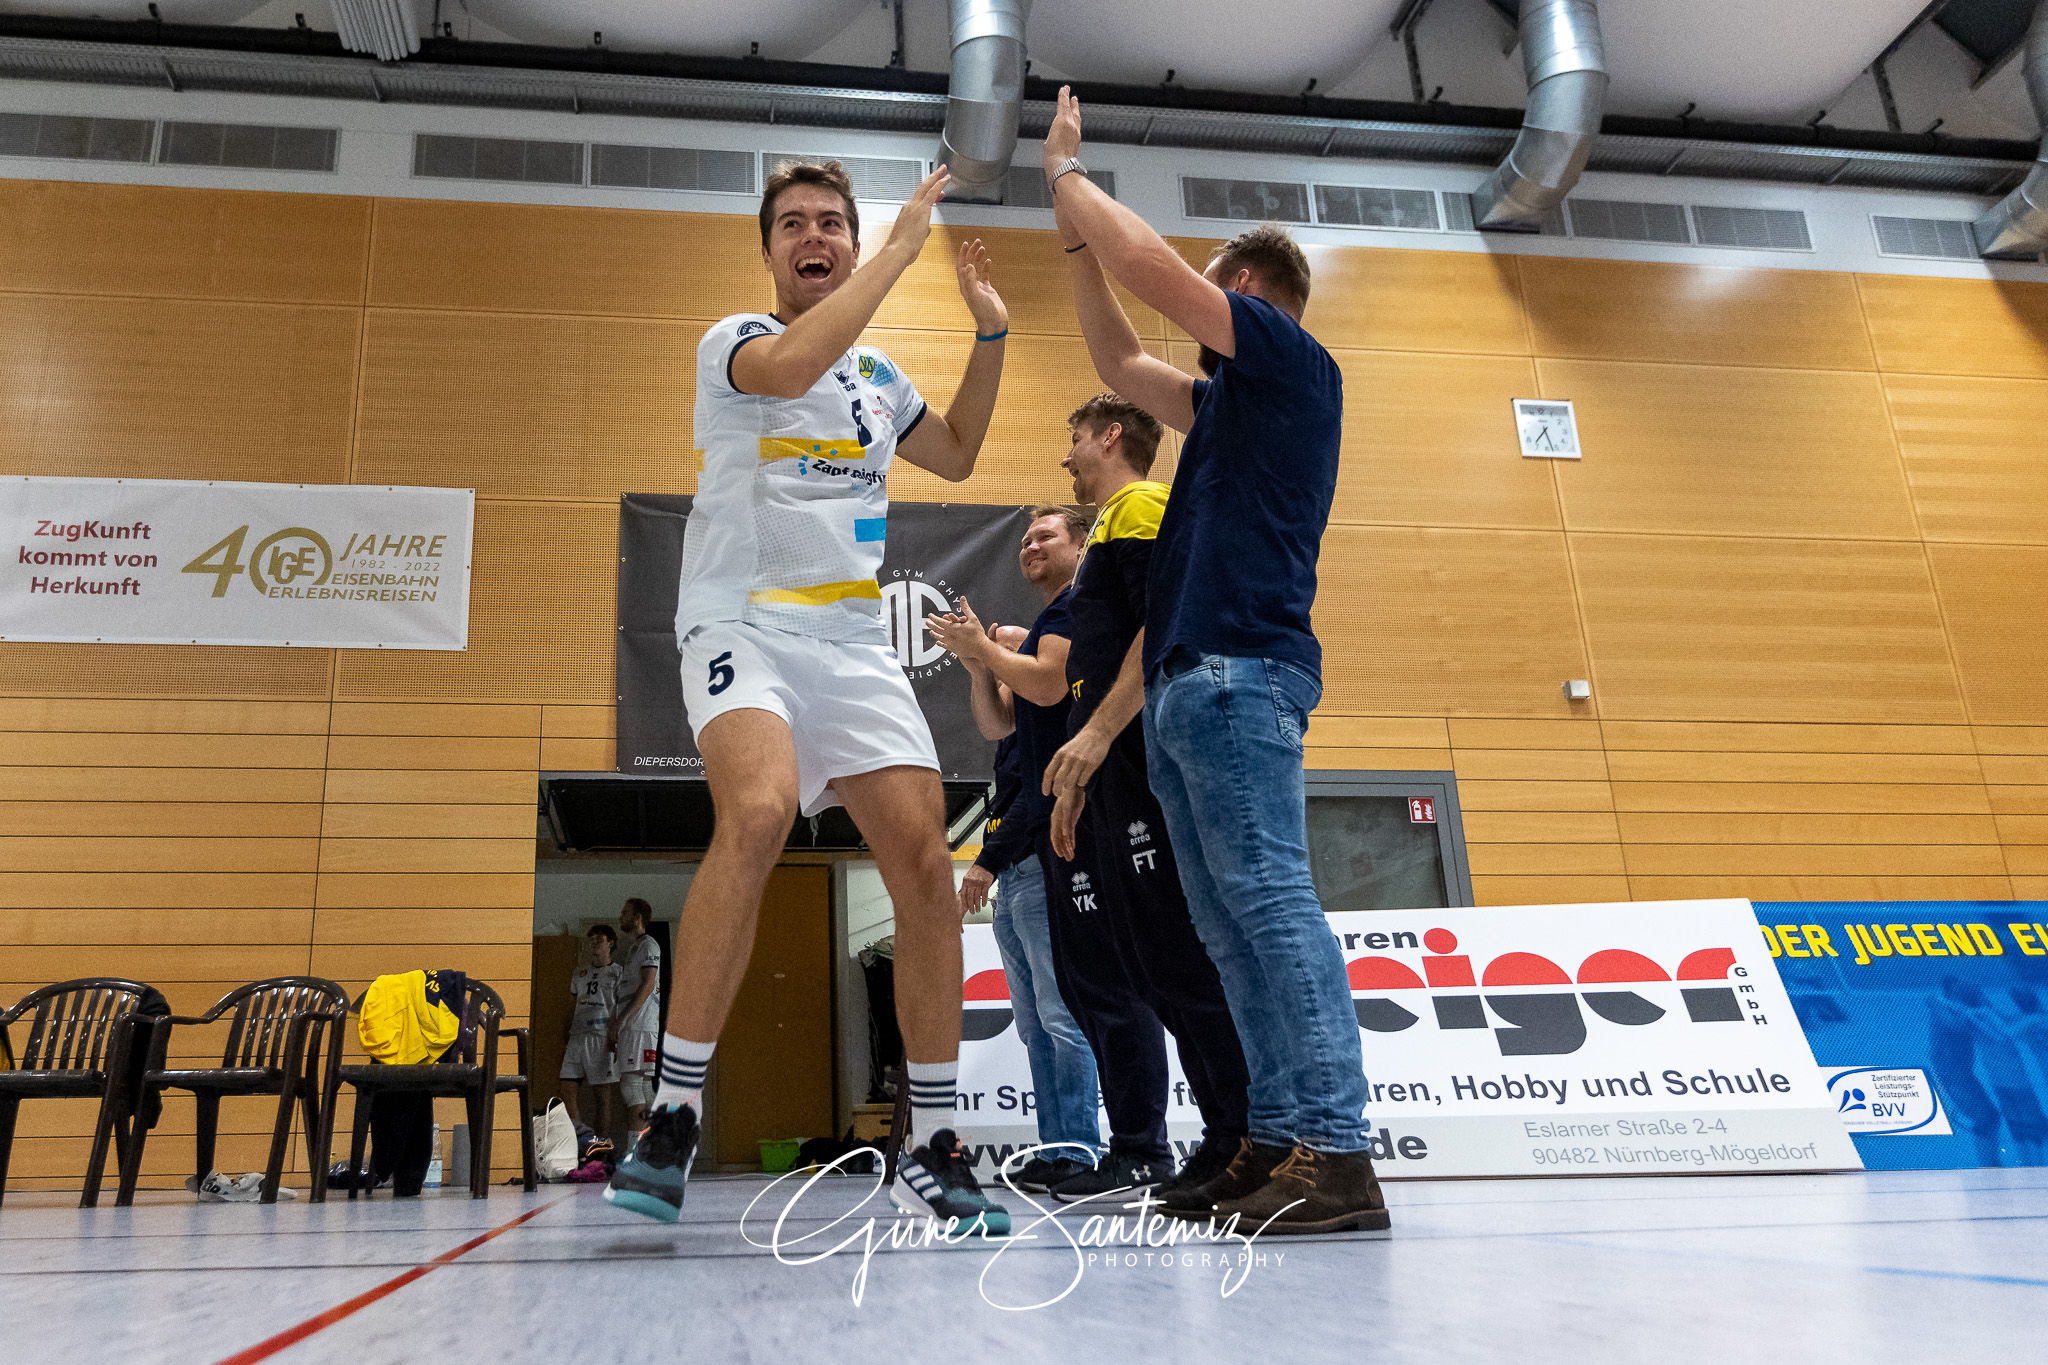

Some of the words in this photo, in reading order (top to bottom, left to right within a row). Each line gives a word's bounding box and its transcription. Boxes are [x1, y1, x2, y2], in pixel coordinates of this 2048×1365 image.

[34, 520, 151, 542] ZugKunft
[19, 545, 107, 566] kommt
[114, 554, 158, 567] von
[339, 533, 447, 561] JAHRE
[267, 546, 316, 584] IGE
[351, 559, 386, 569] 1982
[405, 561, 441, 572] 2022
[893, 569, 923, 579] GYM
[31, 576, 141, 595] Herkunft
[331, 573, 440, 587] EISENBAHN
[268, 586, 437, 602] ERLEBNISREISEN
[708, 651, 735, 696] 5
[634, 756, 704, 767] DIEPERSDOR
[1132, 849, 1157, 874] FT
[1072, 893, 1098, 913] YK
[1334, 931, 1419, 950] ren
[1844, 923, 2003, 965] JUGEND
[586, 981, 599, 995] 13
[1366, 1082, 1442, 1106] ren,
[1451, 1073, 1568, 1105] Hobby
[1582, 1070, 1653, 1098] und
[1662, 1067, 1791, 1096] Schule
[1871, 1074, 1916, 1082] Zertifizierter
[1874, 1082, 1915, 1091] Leistungs-
[1877, 1090, 1920, 1099] Stützpunkt
[1871, 1102, 1905, 1117] BVV
[1523, 1120, 1610, 1138] Eslarner
[1617, 1118, 1688, 1136] Straße
[1692, 1117, 1728, 1135] 2-4
[1532, 1147, 1600, 1165] 90482
[1603, 1142, 1818, 1166] Nürnberg-Mögeldorf
